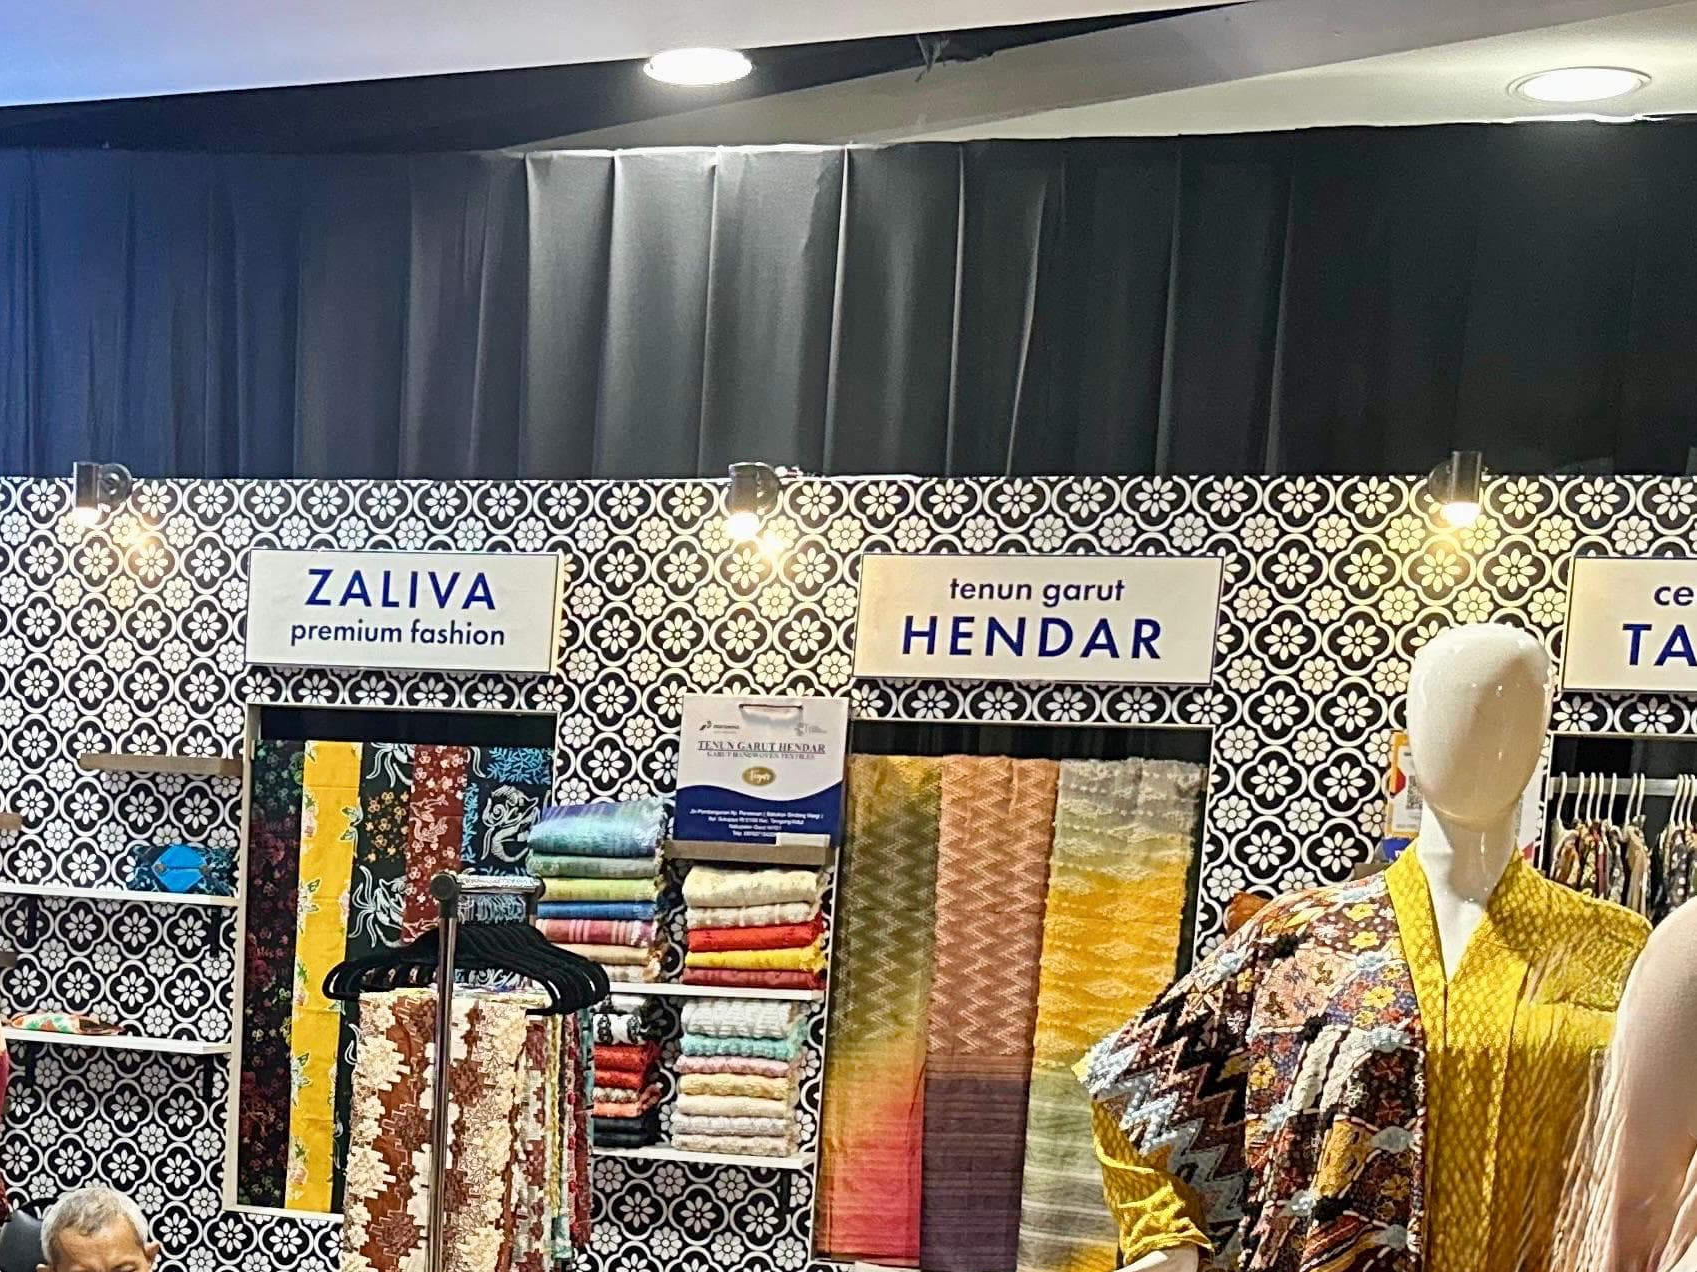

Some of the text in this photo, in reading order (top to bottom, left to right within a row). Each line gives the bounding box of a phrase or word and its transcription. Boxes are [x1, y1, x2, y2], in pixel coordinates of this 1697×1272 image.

[304, 568, 496, 610] ZALIVA
[949, 578, 1125, 608] tenun garut
[290, 618, 505, 647] premium fashion
[902, 615, 1162, 660] HENDAR
[698, 740, 826, 754] TENUN GARUT HENDAR
